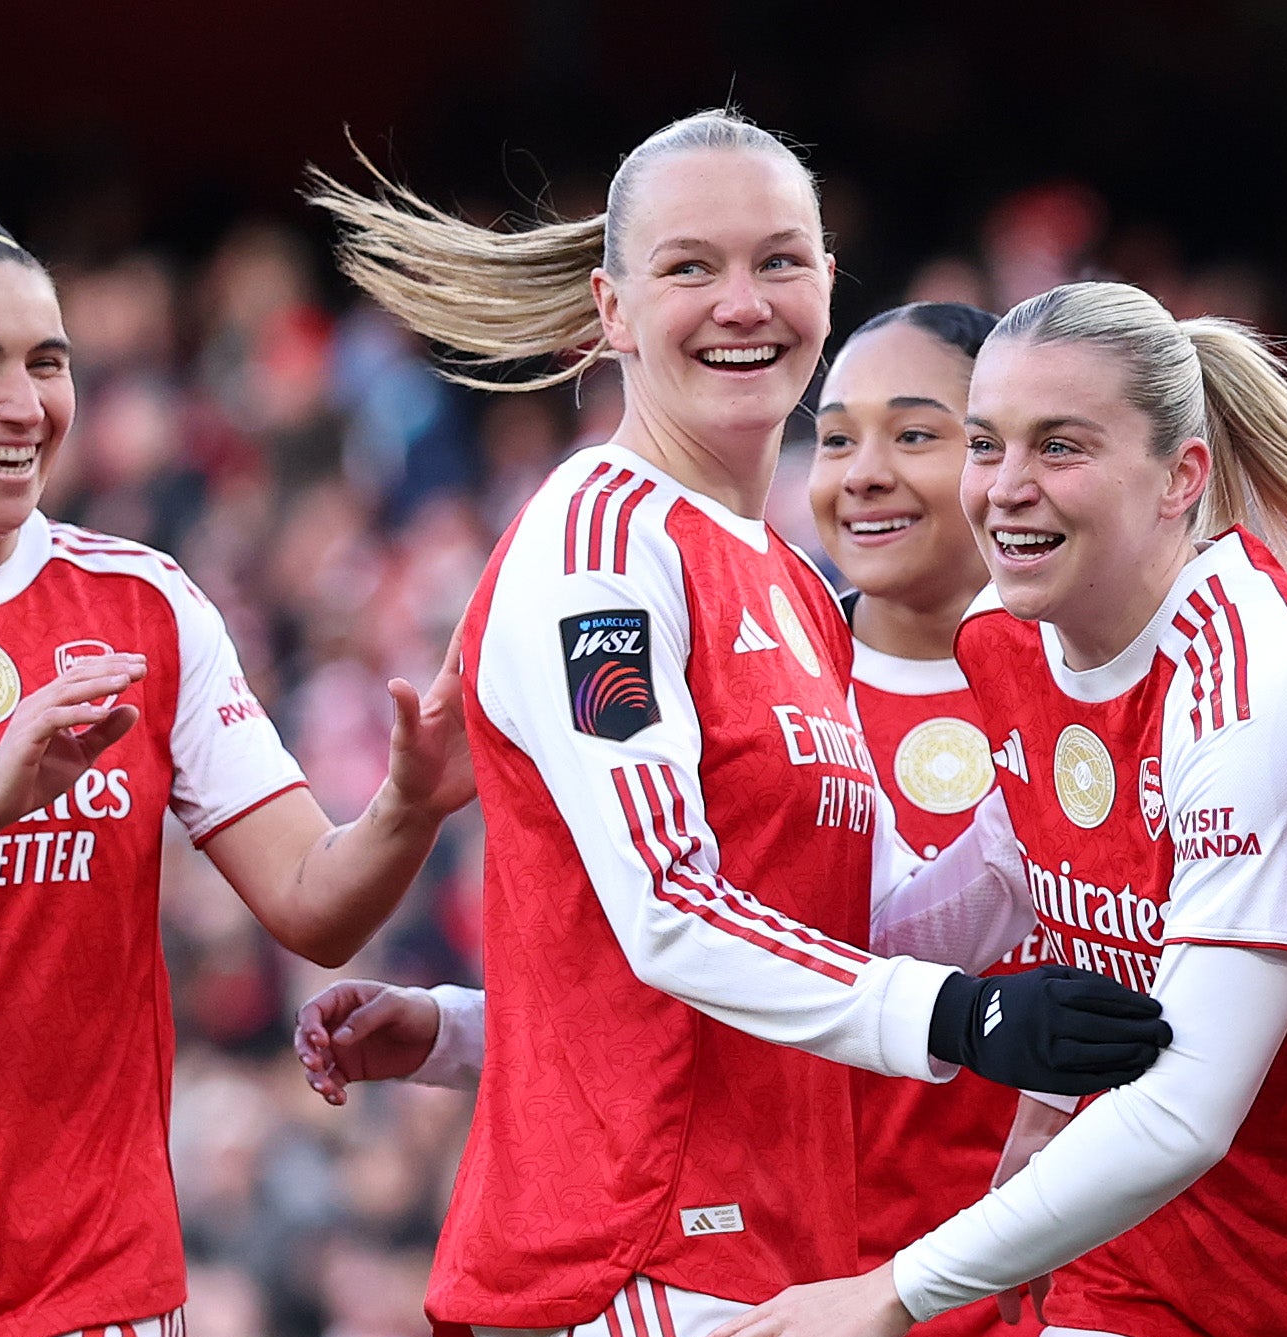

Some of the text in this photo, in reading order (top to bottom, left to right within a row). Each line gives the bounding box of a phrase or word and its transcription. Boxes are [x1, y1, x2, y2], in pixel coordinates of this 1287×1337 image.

[592, 617, 642, 628] BARCLAYS
[569, 629, 645, 661] WSL
[1178, 807, 1235, 835] VISIT
[1173, 832, 1262, 864] WANDA
[1016, 838, 1172, 948] mirate
